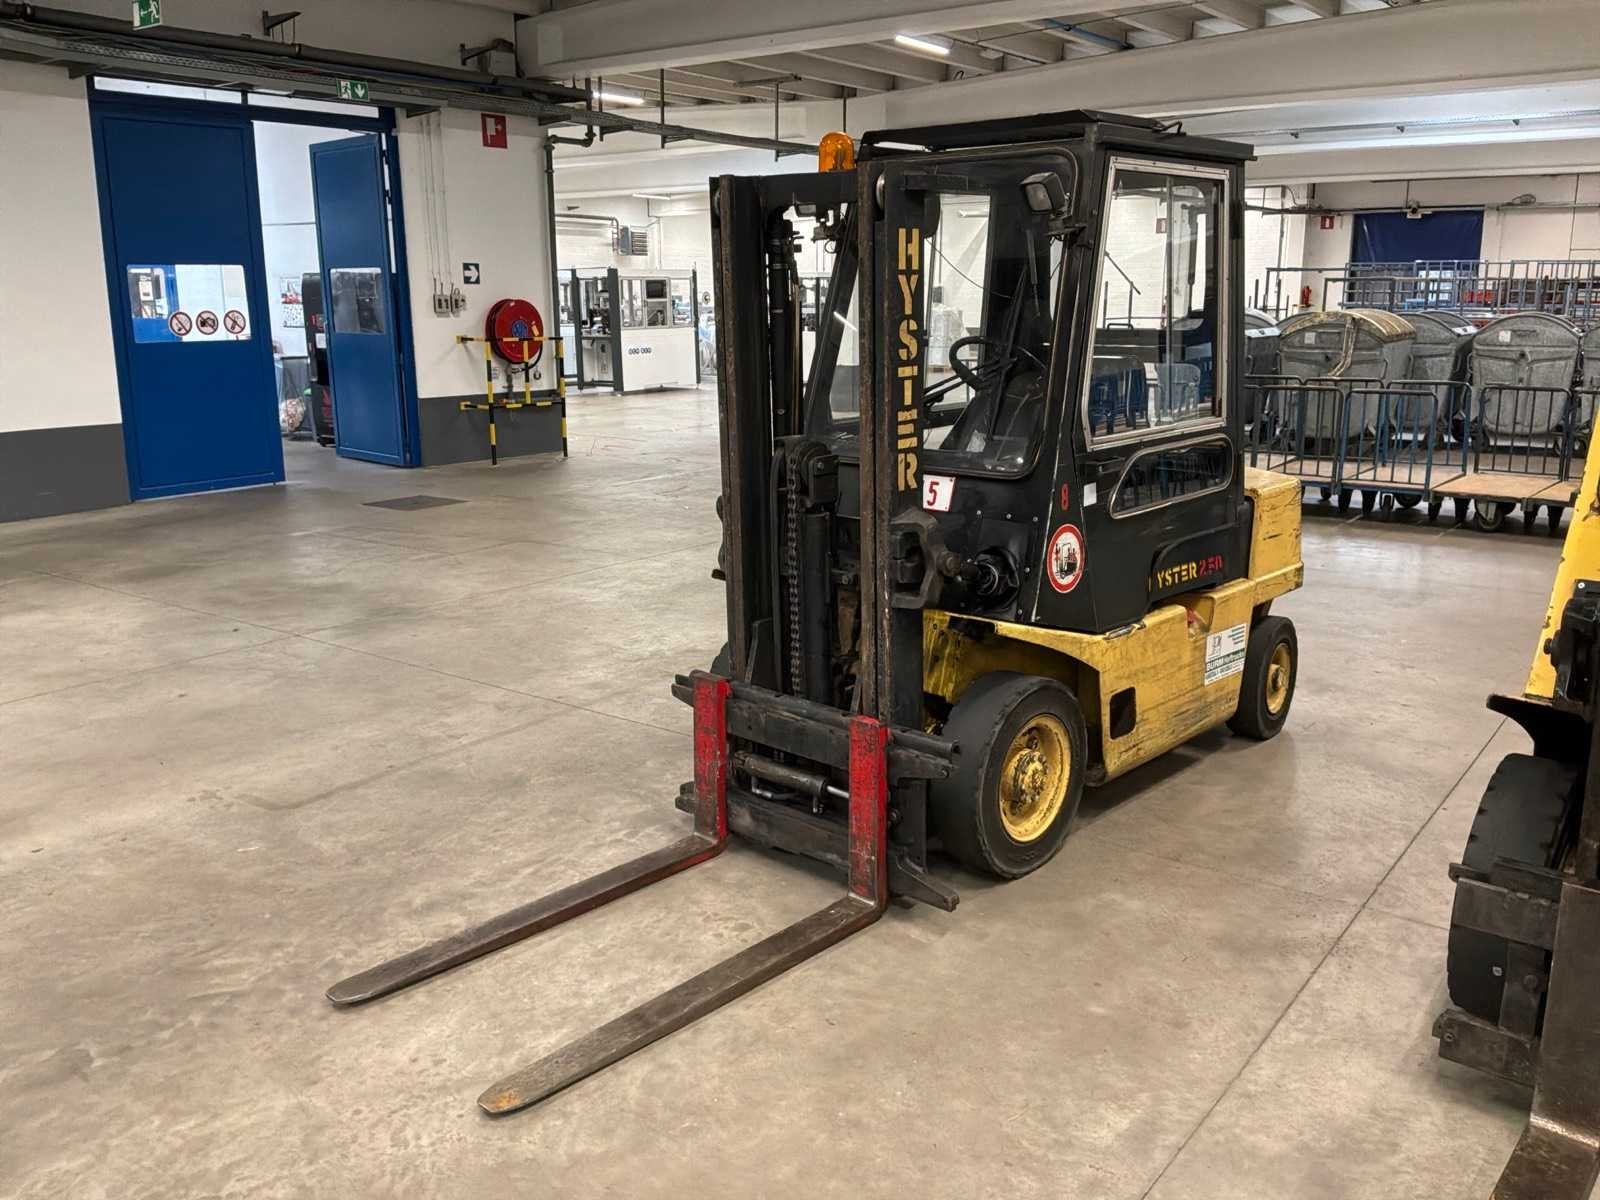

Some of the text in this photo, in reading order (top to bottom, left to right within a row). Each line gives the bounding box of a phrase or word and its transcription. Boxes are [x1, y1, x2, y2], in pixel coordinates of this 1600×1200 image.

[898, 228, 920, 492] HYSTER
[926, 480, 940, 508] 5
[1060, 483, 1070, 511] 8
[1148, 560, 1198, 592] YSTER
